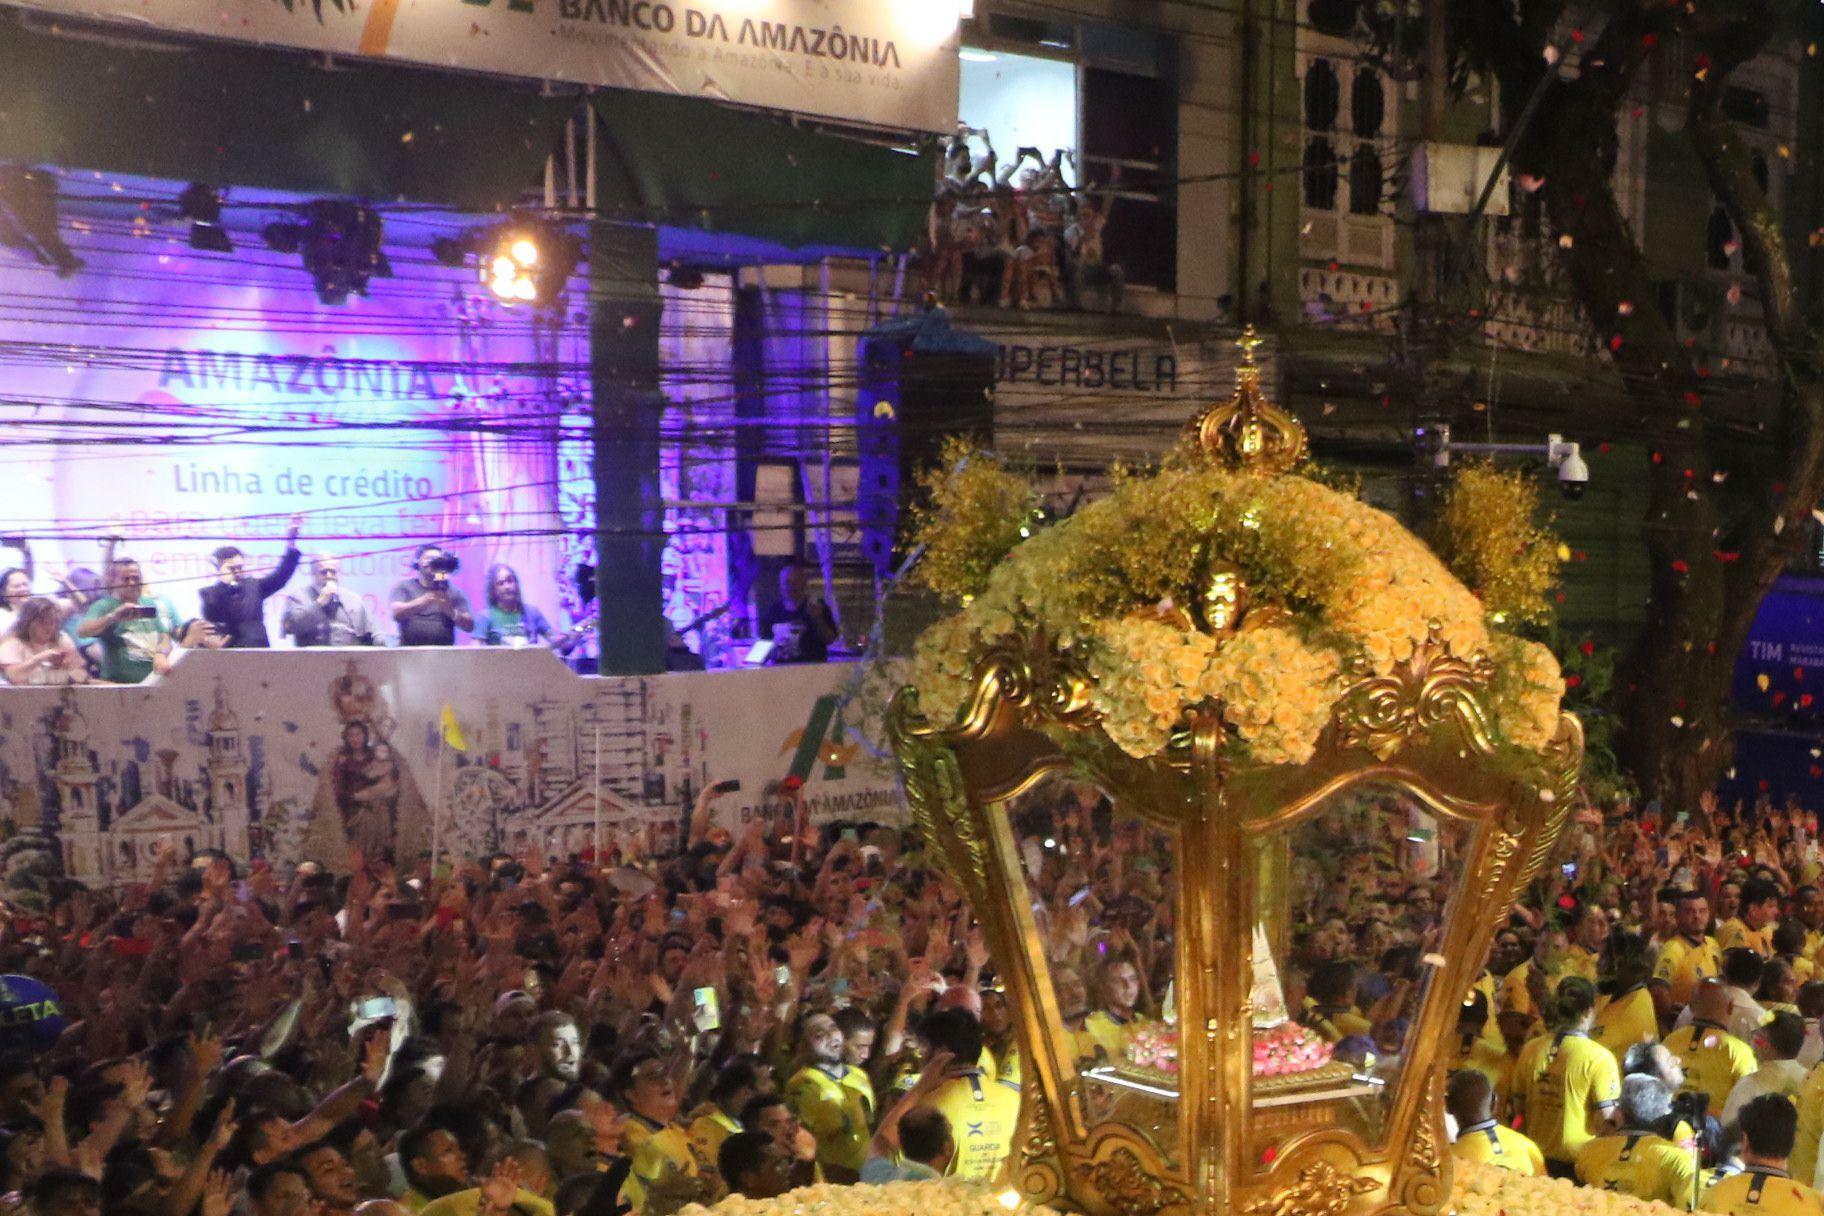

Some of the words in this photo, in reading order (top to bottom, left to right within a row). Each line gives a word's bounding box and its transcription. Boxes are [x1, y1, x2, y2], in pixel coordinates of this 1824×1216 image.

[559, 0, 675, 33] BANCO
[685, 9, 729, 42] DA
[738, 18, 901, 69] AMAZÔNIA
[158, 344, 439, 401] AMAZÔNIA
[173, 463, 264, 495] Linha
[274, 466, 314, 497] de
[325, 467, 432, 501] crédito
[1750, 641, 1783, 662] TIM
